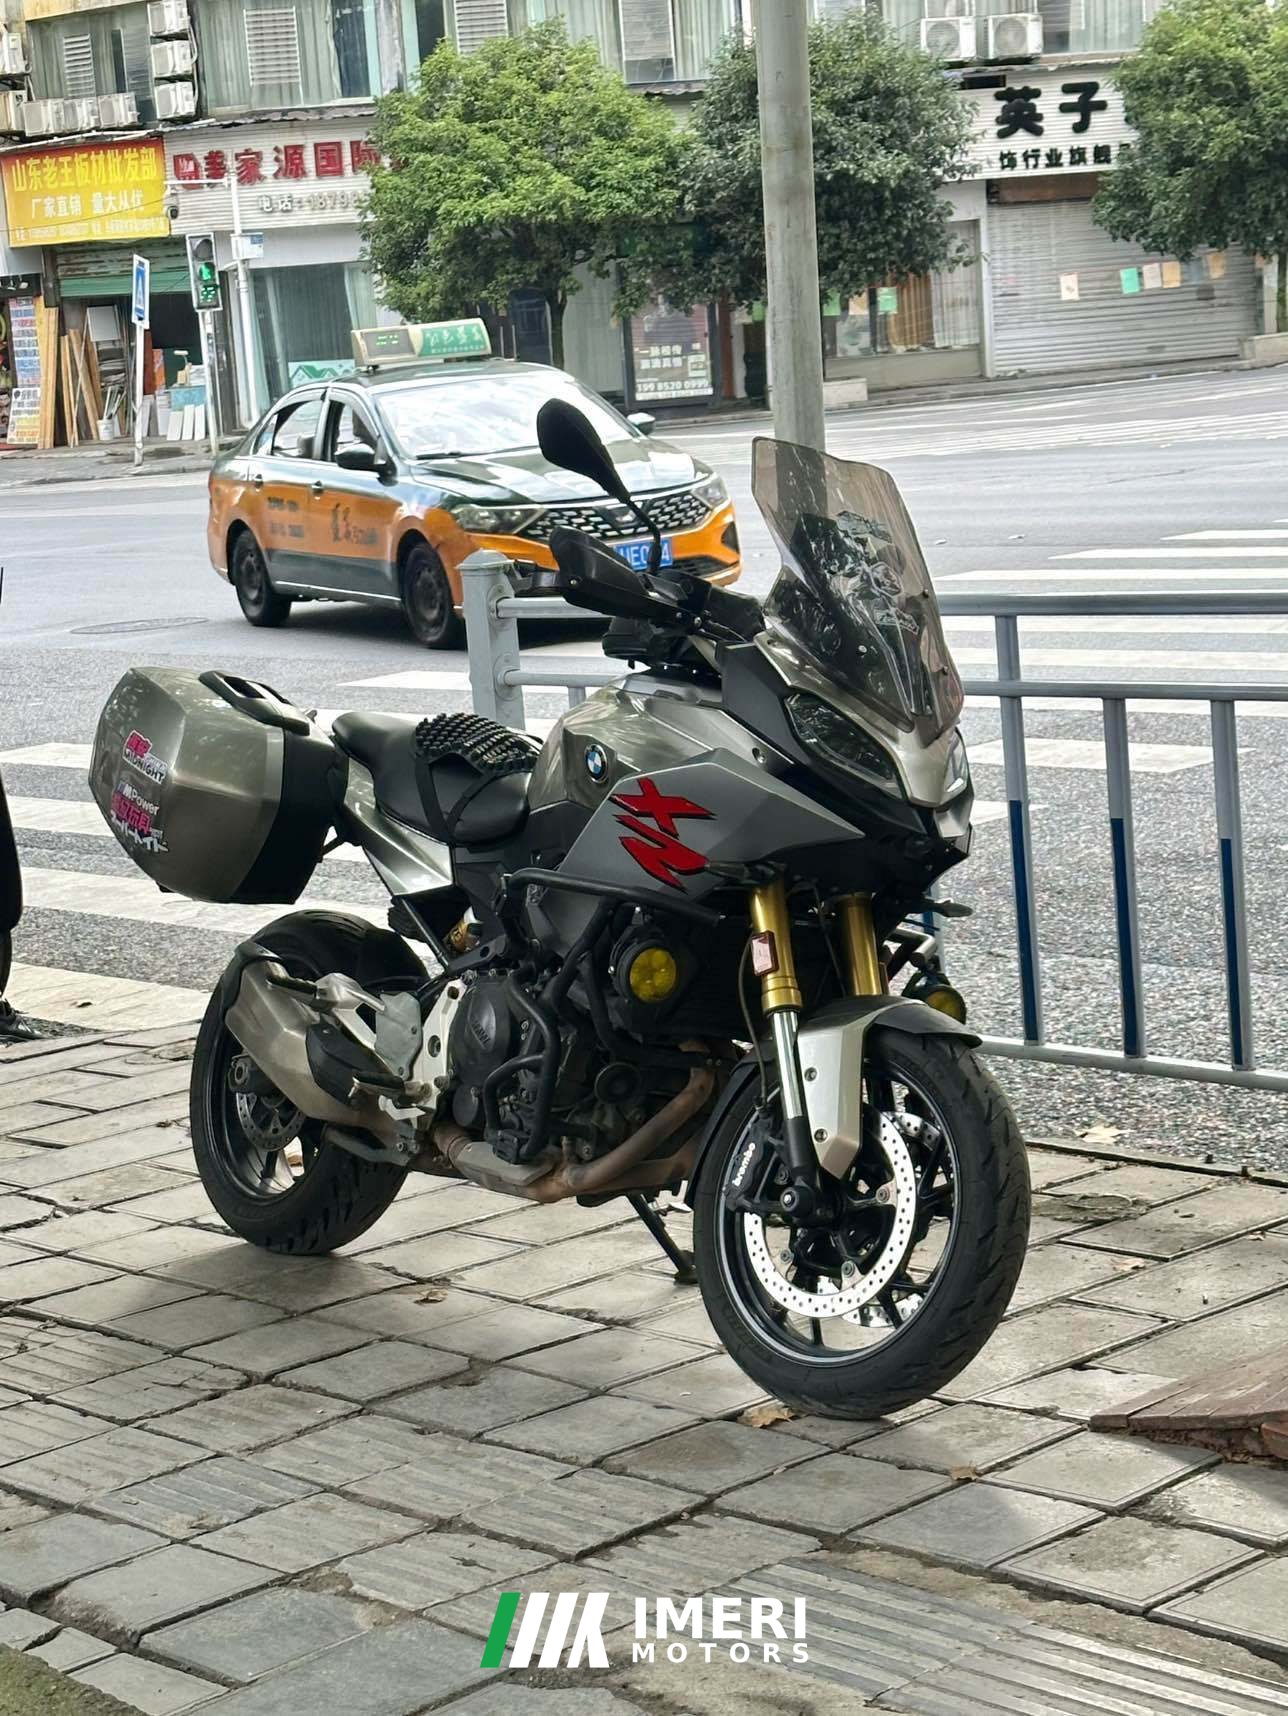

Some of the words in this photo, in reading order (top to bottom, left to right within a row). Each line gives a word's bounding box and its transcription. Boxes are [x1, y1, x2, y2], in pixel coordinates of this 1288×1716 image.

[994, 81, 1107, 138] 英子
[12, 146, 157, 192] 山东老王板材批发部
[1000, 143, 1131, 170] 饰行业旗舰
[732, 1142, 756, 1187] brembo
